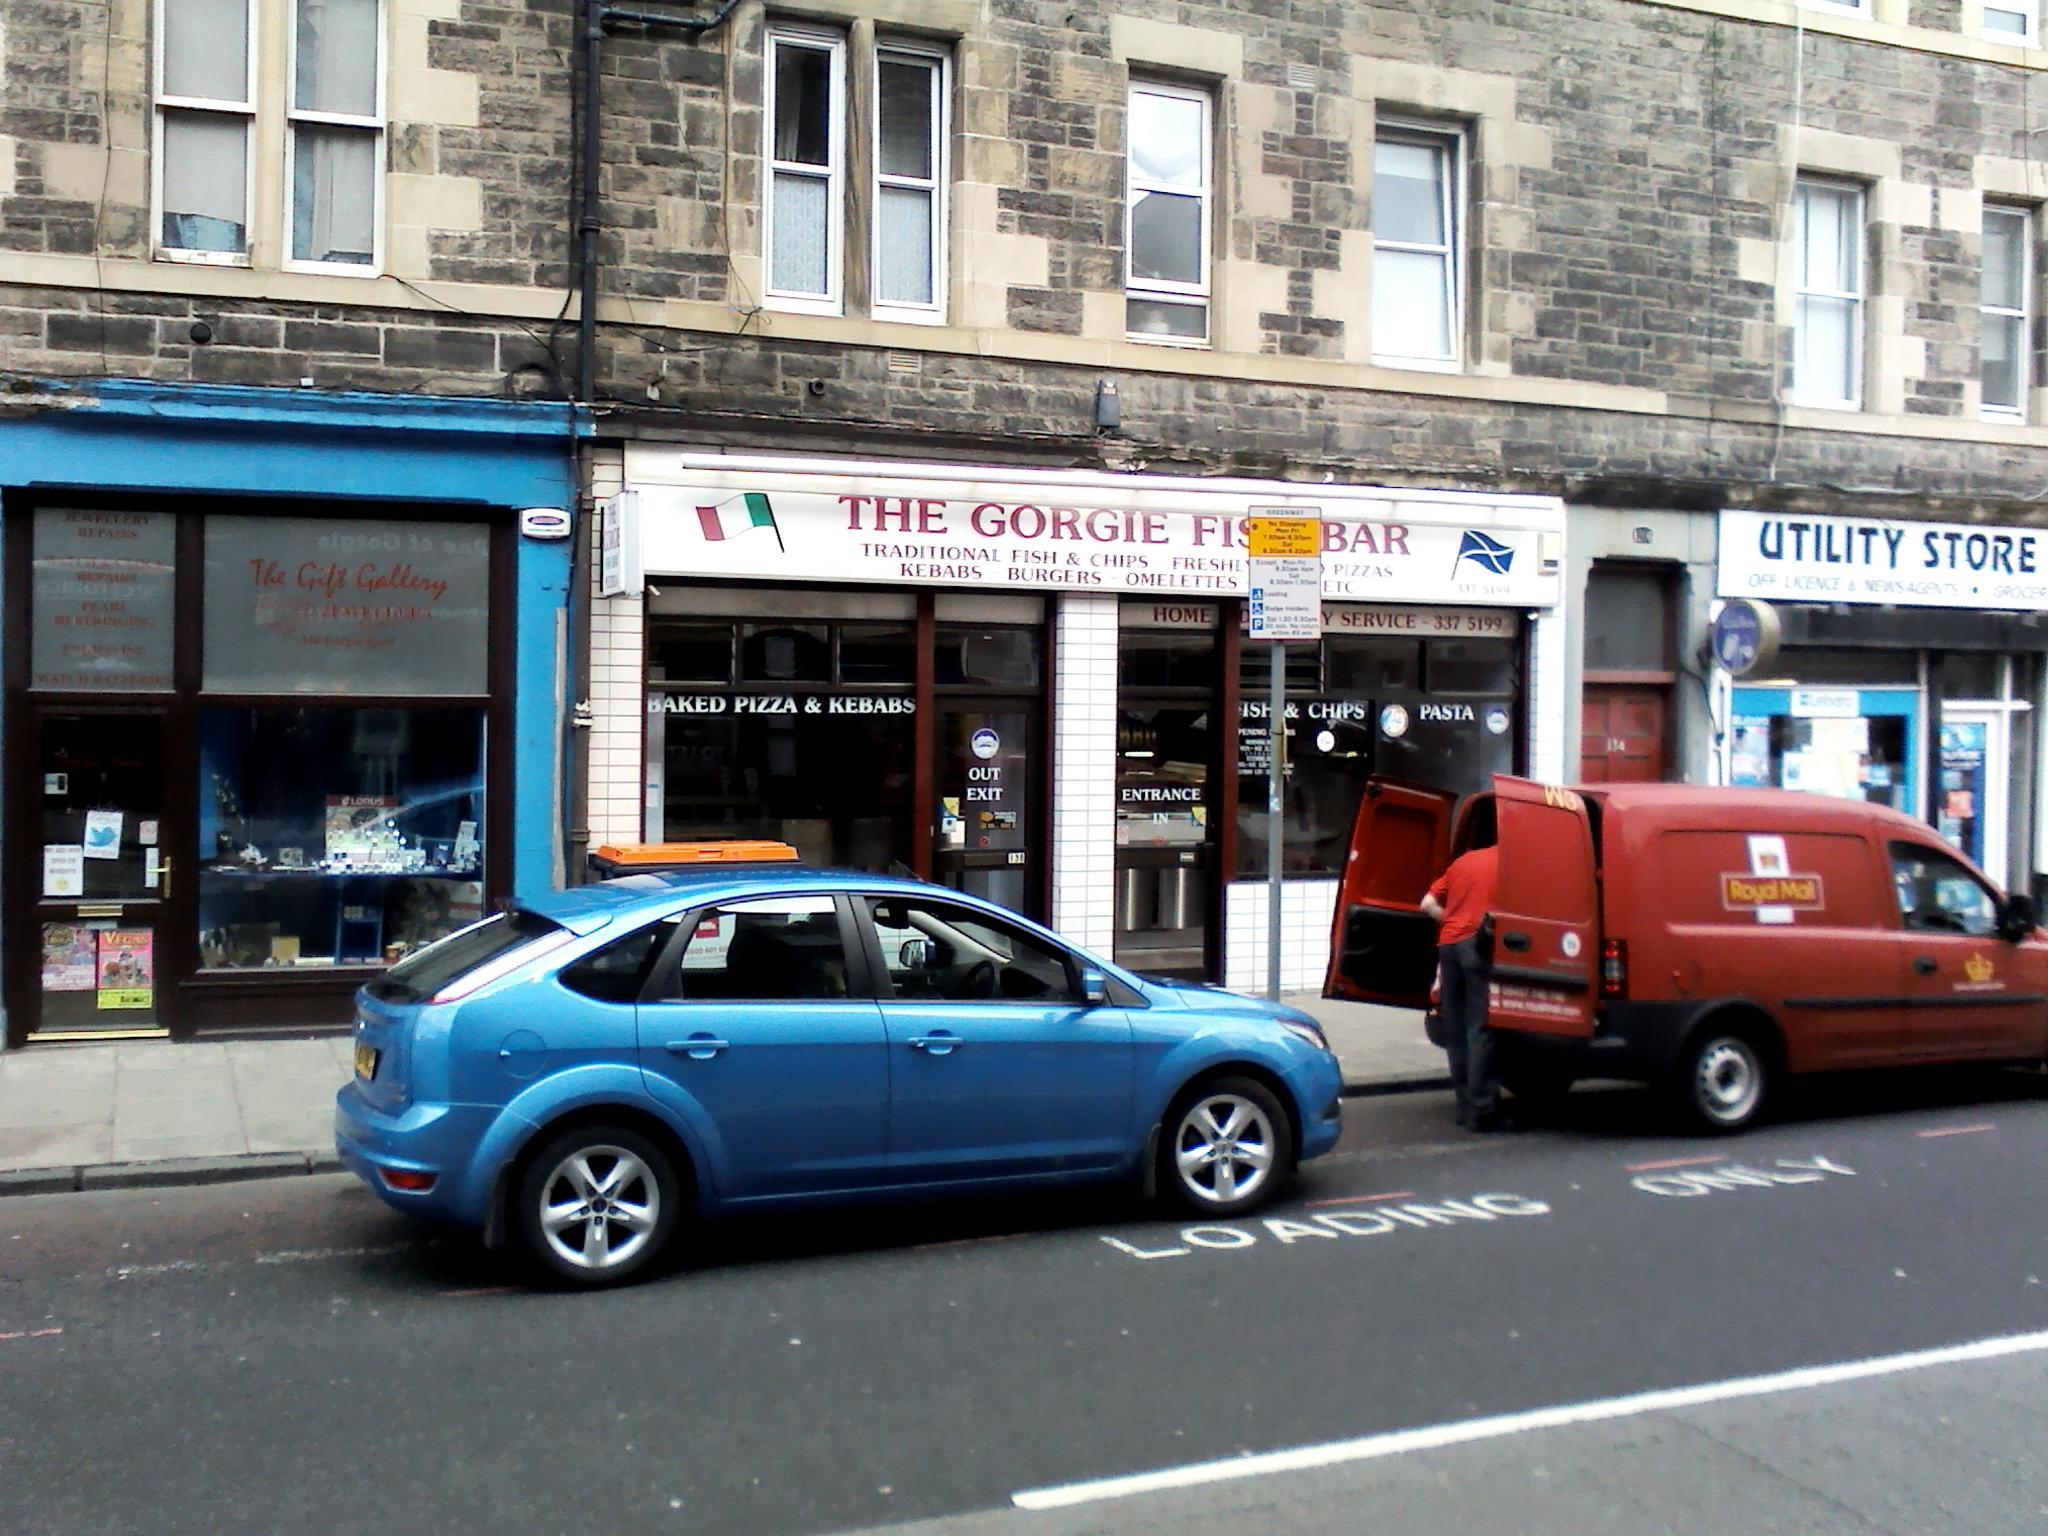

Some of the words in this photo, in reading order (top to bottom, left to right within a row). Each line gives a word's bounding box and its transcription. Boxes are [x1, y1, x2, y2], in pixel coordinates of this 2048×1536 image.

[77, 527, 138, 539] REPAIRS
[838, 494, 948, 534] THE
[970, 502, 1169, 544] GORGIE
[1192, 514, 1250, 549] FIS
[1320, 521, 1411, 556] BAR
[1759, 520, 1905, 569] UTILITY
[1924, 531, 2037, 576] STORE
[861, 542, 1000, 562] TRADITIONAL
[1012, 549, 1057, 565] FISH
[1066, 552, 1080, 566] &
[1090, 553, 1149, 569] CHIPS
[1172, 556, 1250, 573] FRESHL
[1334, 563, 1393, 578] PIZZAS
[77, 572, 138, 583] REPAIRS
[250, 558, 286, 588] The
[296, 560, 348, 598] Gift
[356, 562, 448, 601] Gallery
[900, 563, 982, 580] KEBABS
[1007, 567, 1102, 585] BURGERS
[1125, 572, 1238, 589] OMELETTES
[1323, 580, 1354, 594] ETC
[1748, 573, 1777, 587] OFF
[1784, 573, 1841, 591] LICENCE
[1864, 579, 1959, 595] NEWSAGENTS
[1457, 583, 1480, 594] 337
[1153, 606, 1212, 624] HOME
[1341, 612, 1417, 629] SERVICE
[1433, 614, 1460, 630] 337
[1467, 616, 1503, 631] 5199
[647, 695, 727, 714] BAKED
[733, 696, 798, 714] PIZZA
[803, 697, 822, 714] &
[828, 697, 916, 714] KEBABS
[1284, 702, 1300, 719] &
[1308, 702, 1366, 719] CHIPS
[1419, 703, 1475, 721] PASTA
[968, 766, 1003, 782] OUT
[351, 796, 385, 806] LORUS
[966, 787, 1004, 802] EXIT
[1121, 788, 1201, 801] ENTRANCE
[1152, 812, 1169, 825] IN
[1728, 880, 1778, 903] Royal
[1780, 880, 1815, 900] Mail
[1099, 1191, 1552, 1260] LOADING
[1630, 1154, 1857, 1198] ONLY
